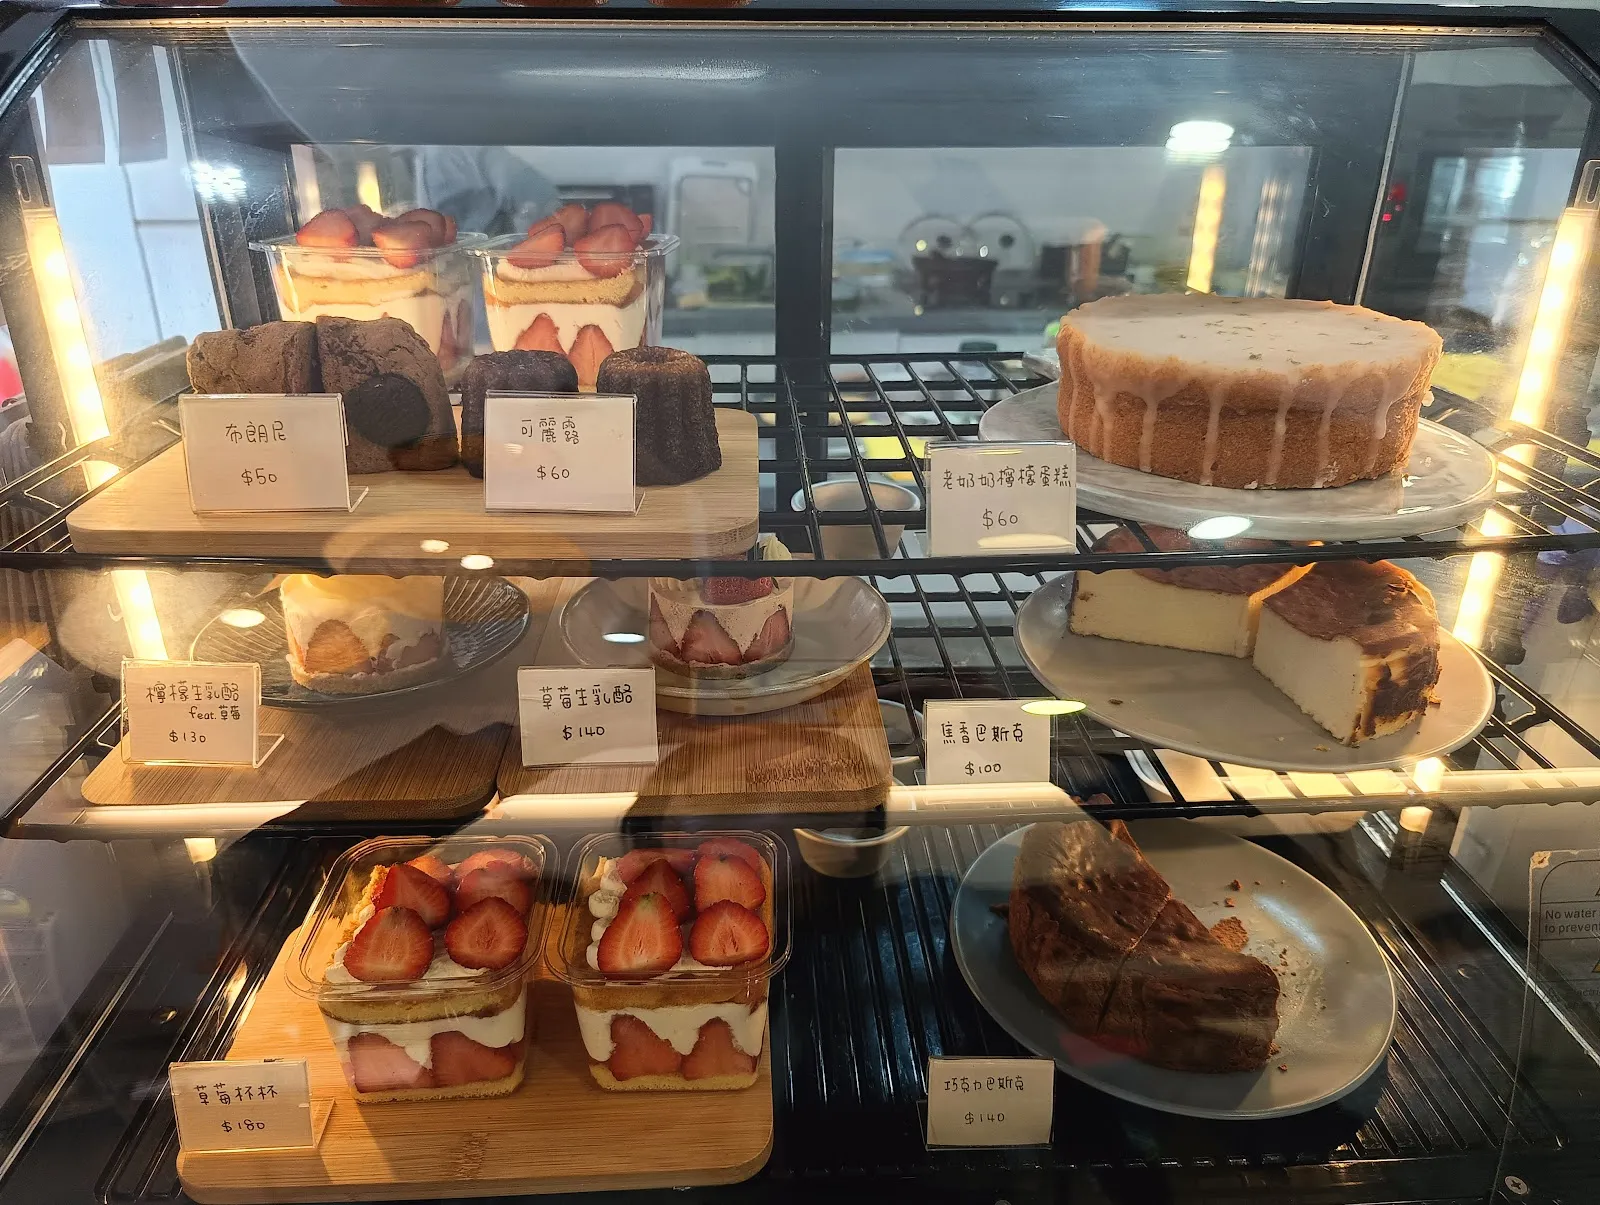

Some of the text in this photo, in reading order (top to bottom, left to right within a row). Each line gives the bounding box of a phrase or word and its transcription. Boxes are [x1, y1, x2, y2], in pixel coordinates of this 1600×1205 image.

[225, 420, 287, 444] 布朗尼
[521, 416, 580, 445] 可麗露
[241, 467, 278, 486] $50
[536, 465, 570, 480] $60
[942, 464, 1072, 490] 老奶奶檸檬蛋糕
[982, 508, 1019, 530] $60
[145, 680, 240, 704] 檸檬生乳酪
[538, 683, 633, 710] 草莓生乳酪
[188, 705, 217, 720] feat.
[168, 729, 207, 743] $130
[562, 725, 606, 741] $140
[940, 721, 1024, 745] 焦香巴斯克
[964, 761, 1002, 777] $100
[1545, 909, 1597, 920] No water
[1544, 923, 1556, 934] to
[944, 1074, 1024, 1093] 巧克力巴斯克
[194, 1082, 278, 1106] 草莓杯杯
[221, 1118, 266, 1133] $180
[964, 1111, 1005, 1125] $140
